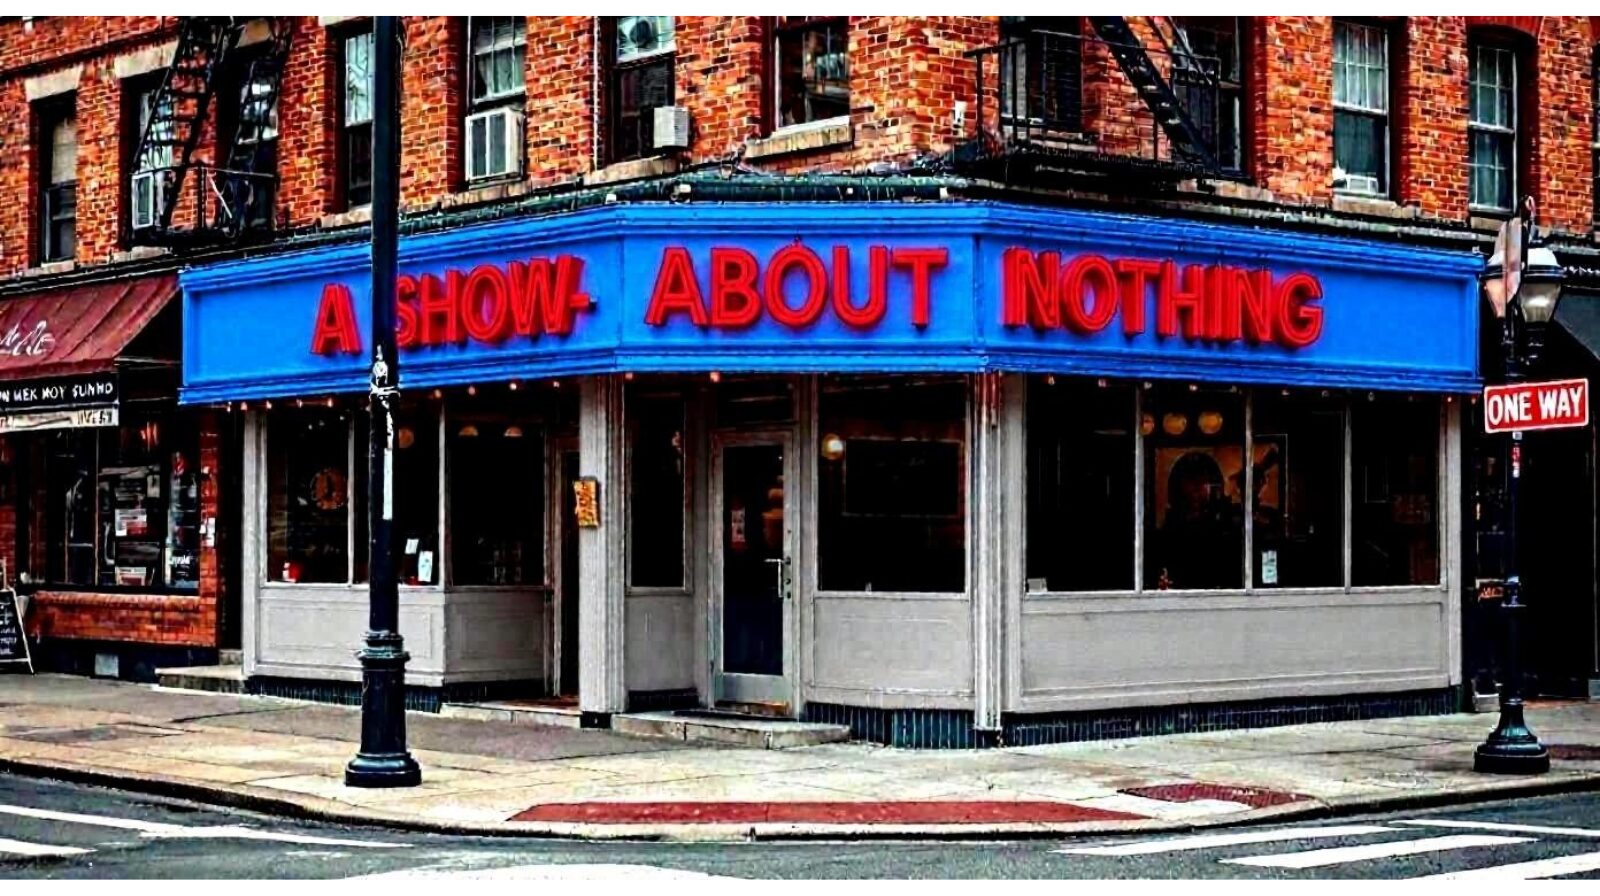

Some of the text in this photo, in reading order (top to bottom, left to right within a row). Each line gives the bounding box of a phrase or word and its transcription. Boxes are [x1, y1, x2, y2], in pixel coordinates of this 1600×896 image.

[311, 283, 362, 355] A
[645, 244, 950, 327] ABOUT
[1002, 246, 1325, 348] NOTHING
[1488, 385, 1584, 426] ONE WAY
